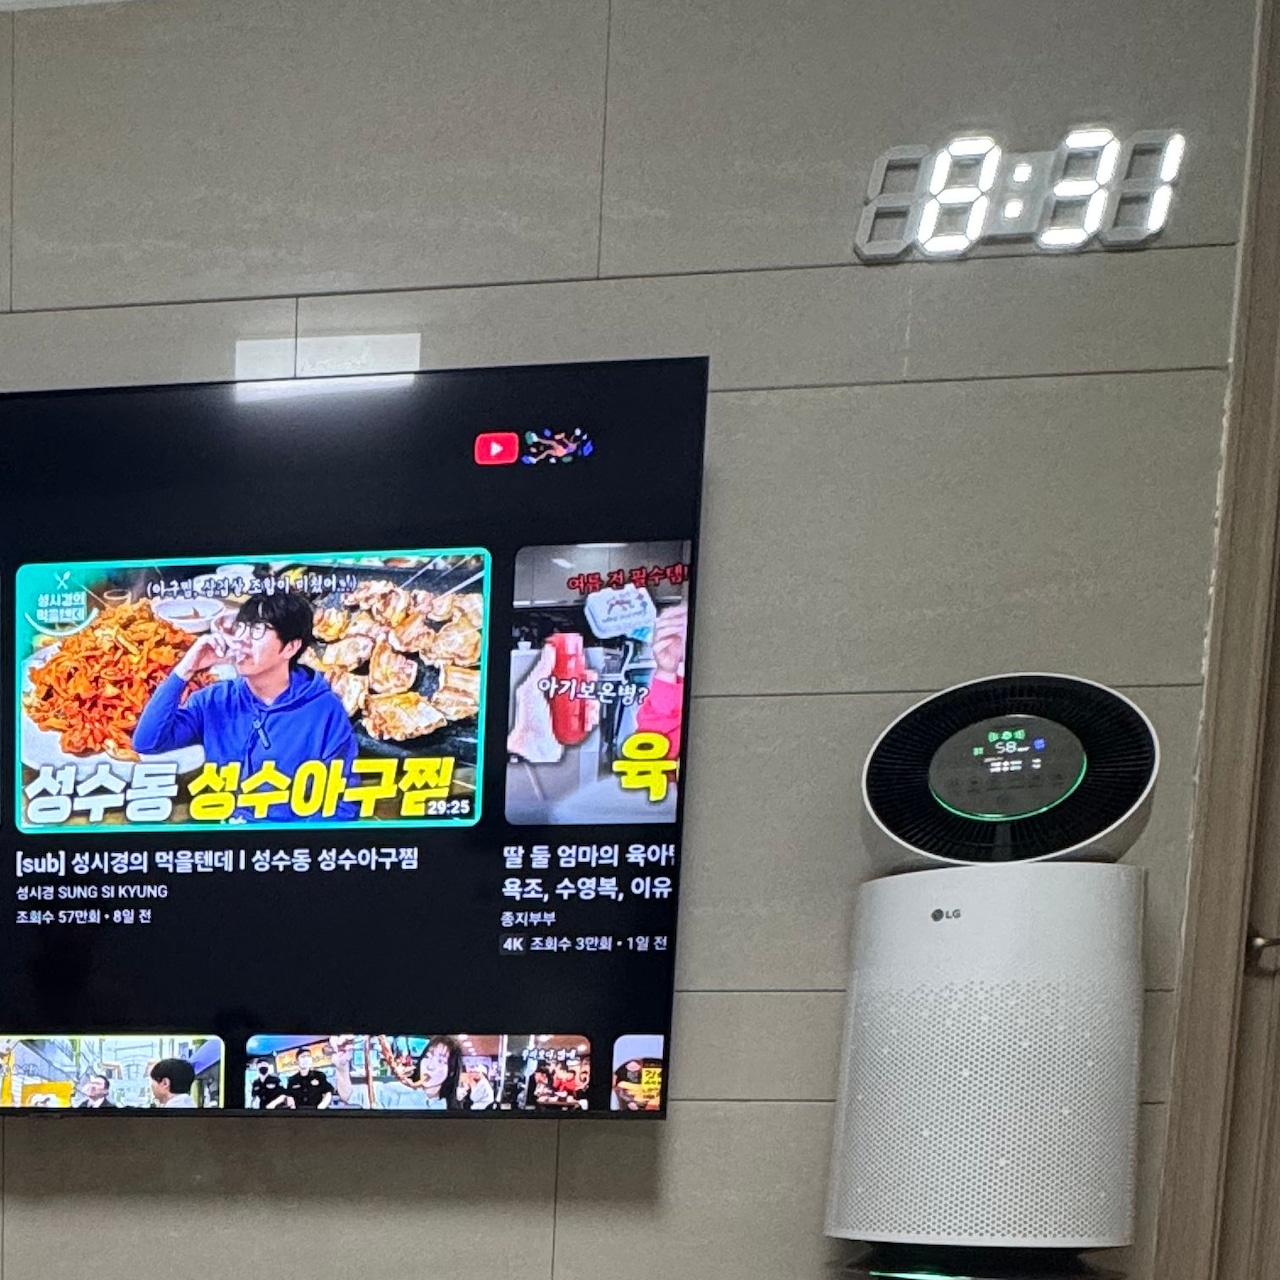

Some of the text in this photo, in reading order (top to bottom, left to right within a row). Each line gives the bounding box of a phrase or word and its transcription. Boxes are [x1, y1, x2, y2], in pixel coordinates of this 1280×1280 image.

[917, 129, 1185, 255] 8:31
[613, 732, 679, 802] 육
[25, 756, 455, 824] 성수동 성수아구찜
[427, 800, 470, 815] 29:25
[16, 851, 65, 877] [sub]
[72, 851, 148, 874] 성시경의
[155, 850, 233, 873] 먹을텐데
[252, 849, 311, 871] 성수동
[318, 847, 418, 871] 성수아구찜
[503, 846, 524, 868] 딸
[530, 845, 551, 868] 둘
[557, 845, 618, 867] 엄마의
[16, 885, 167, 900] 성시경 SUNG SI KYUNG
[502, 877, 672, 902] 욕조, 수영복, 이유
[16, 909, 151, 925] 조회수 57만회 8일 전
[945, 909, 961, 919] LG
[503, 936, 667, 952] 4K 조회수 3만회 1일 전
